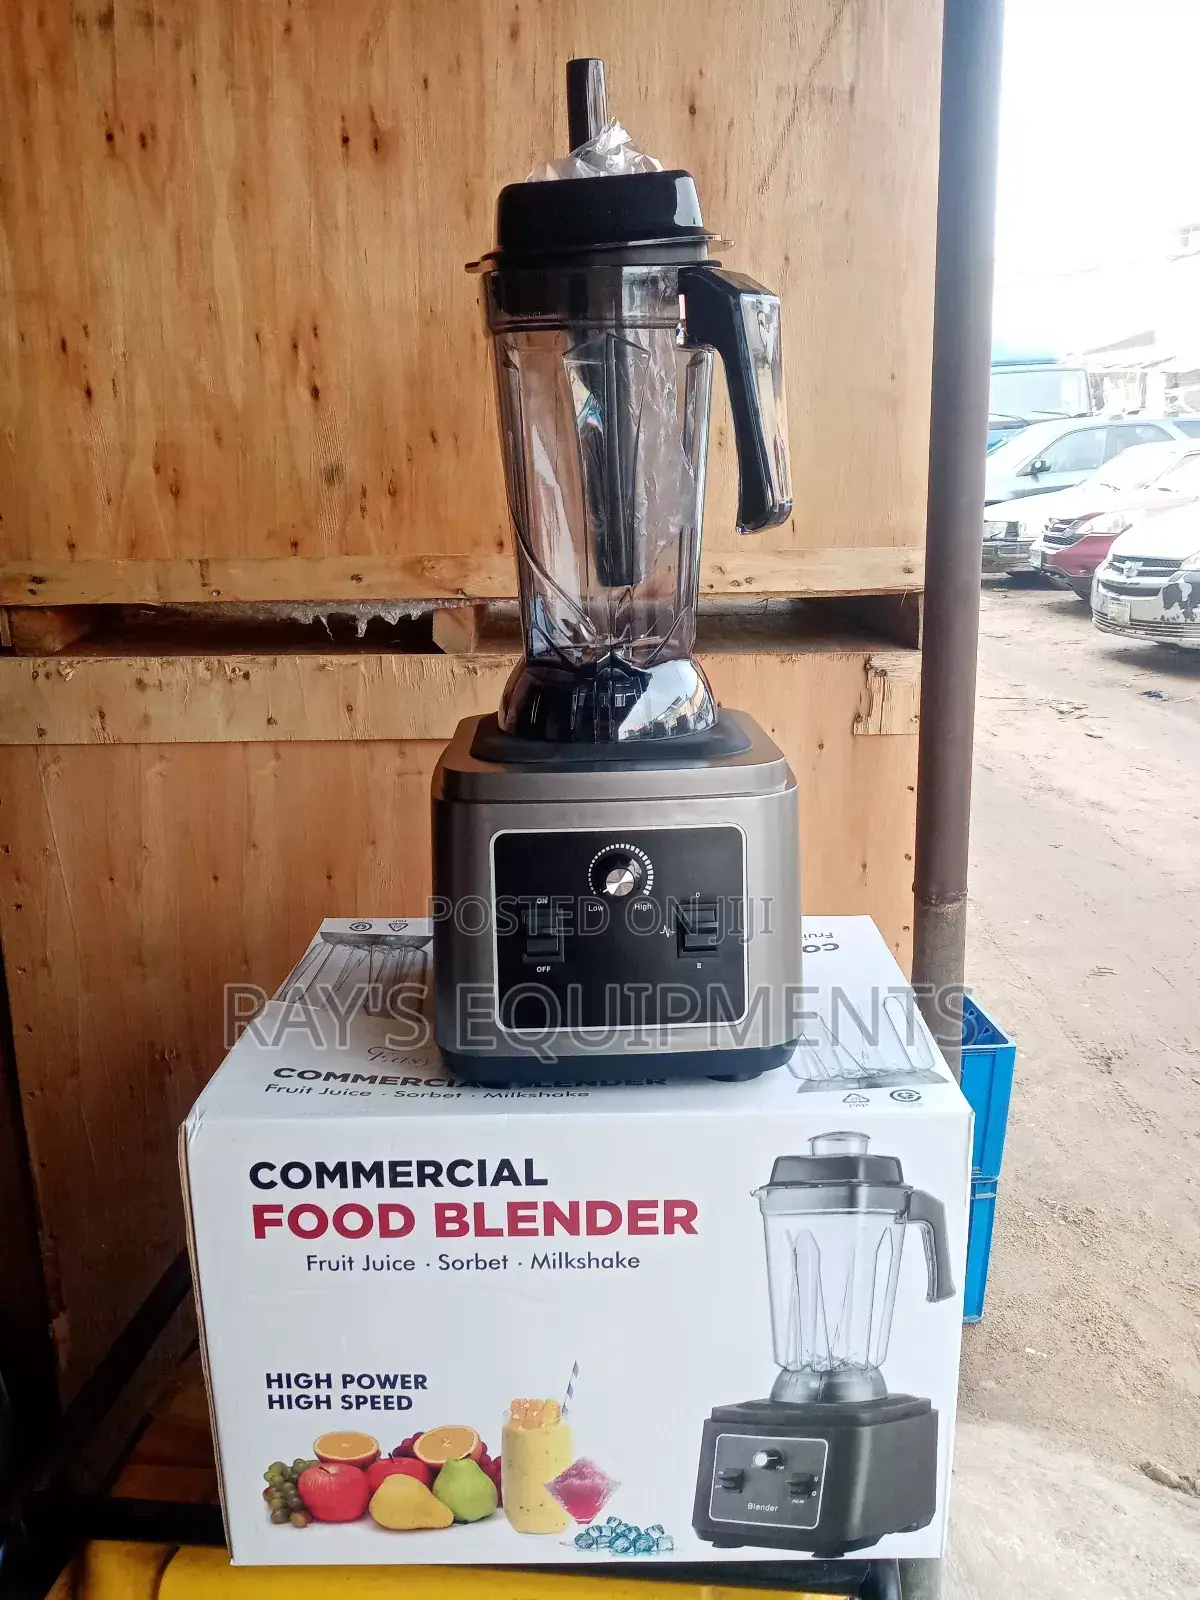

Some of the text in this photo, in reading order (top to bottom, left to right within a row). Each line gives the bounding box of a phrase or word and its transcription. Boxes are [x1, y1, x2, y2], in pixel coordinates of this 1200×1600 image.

[588, 904, 604, 912] Low
[634, 902, 652, 912] High
[536, 965, 551, 973] OFF
[264, 1083, 591, 1099] Fruit Juice Sorbet Milkshake
[249, 1158, 548, 1190] COMMERCIAL
[252, 1199, 699, 1240] FOOD BLENDER
[306, 1251, 641, 1273] Fruit Juice Sorbet Milkshake
[265, 1373, 428, 1391] HIGH POWER
[267, 1394, 413, 1411] HIGH SPEED
[747, 1502, 779, 1512] Blender
